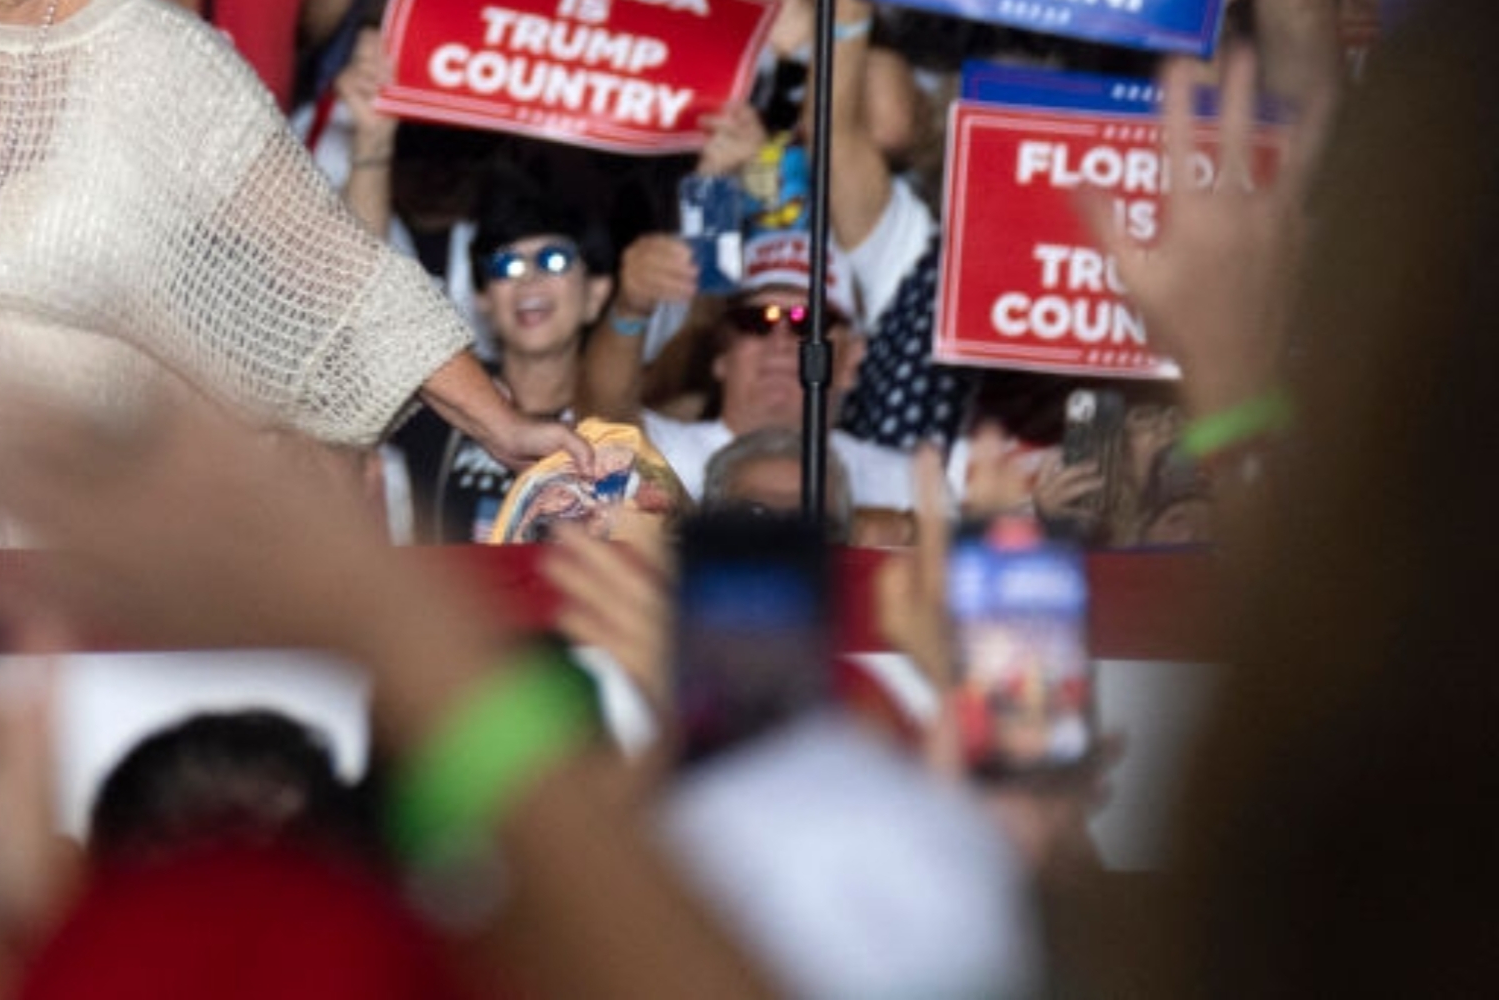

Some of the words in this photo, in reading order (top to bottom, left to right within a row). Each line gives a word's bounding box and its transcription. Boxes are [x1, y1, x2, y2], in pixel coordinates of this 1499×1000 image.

[481, 5, 669, 73] TRUMP
[428, 42, 695, 129] COUNTRY
[1112, 198, 1157, 241] IS
[991, 291, 1149, 346] COUN
